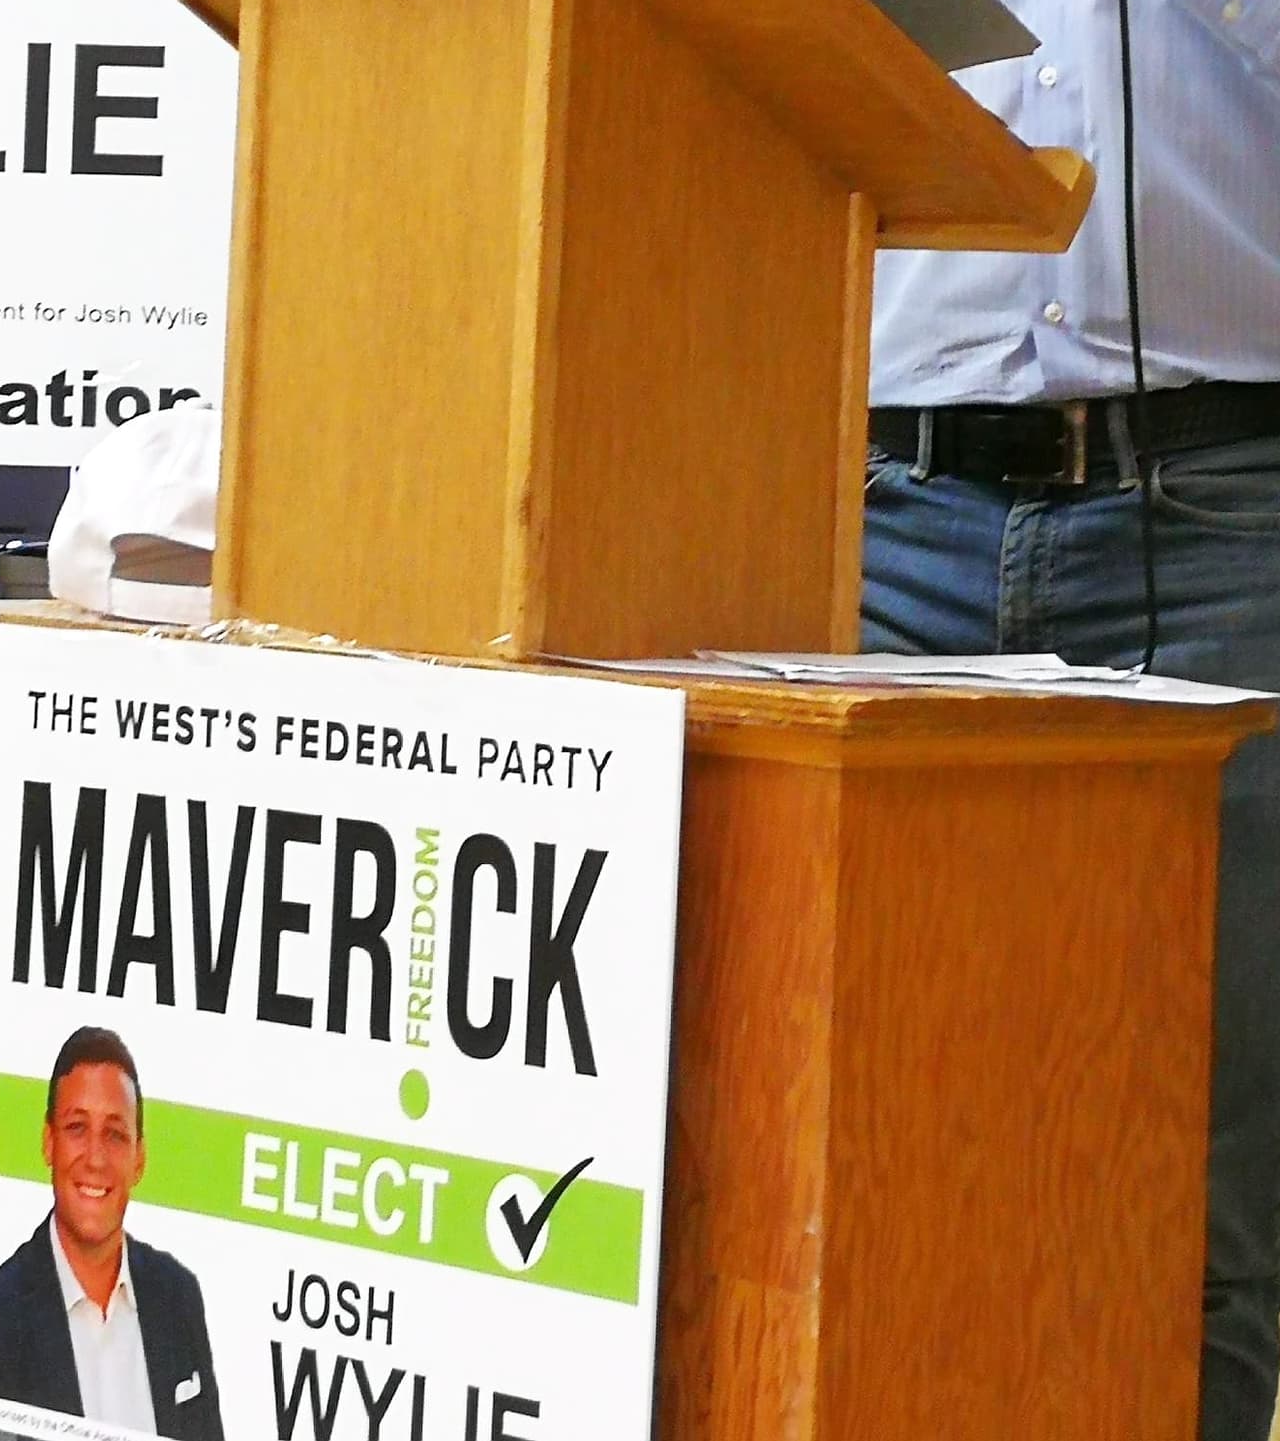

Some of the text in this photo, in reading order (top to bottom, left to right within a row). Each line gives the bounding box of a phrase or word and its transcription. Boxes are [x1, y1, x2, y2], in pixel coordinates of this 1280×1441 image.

[36, 304, 67, 322] for
[76, 305, 132, 324] Josh
[143, 307, 209, 331] Wylie
[30, 692, 613, 792] THE WEST'S FEDERAL PARTY
[408, 831, 440, 1048] FREEDOM
[240, 1132, 449, 1244] ELECT
[272, 1269, 395, 1345] JOSH
